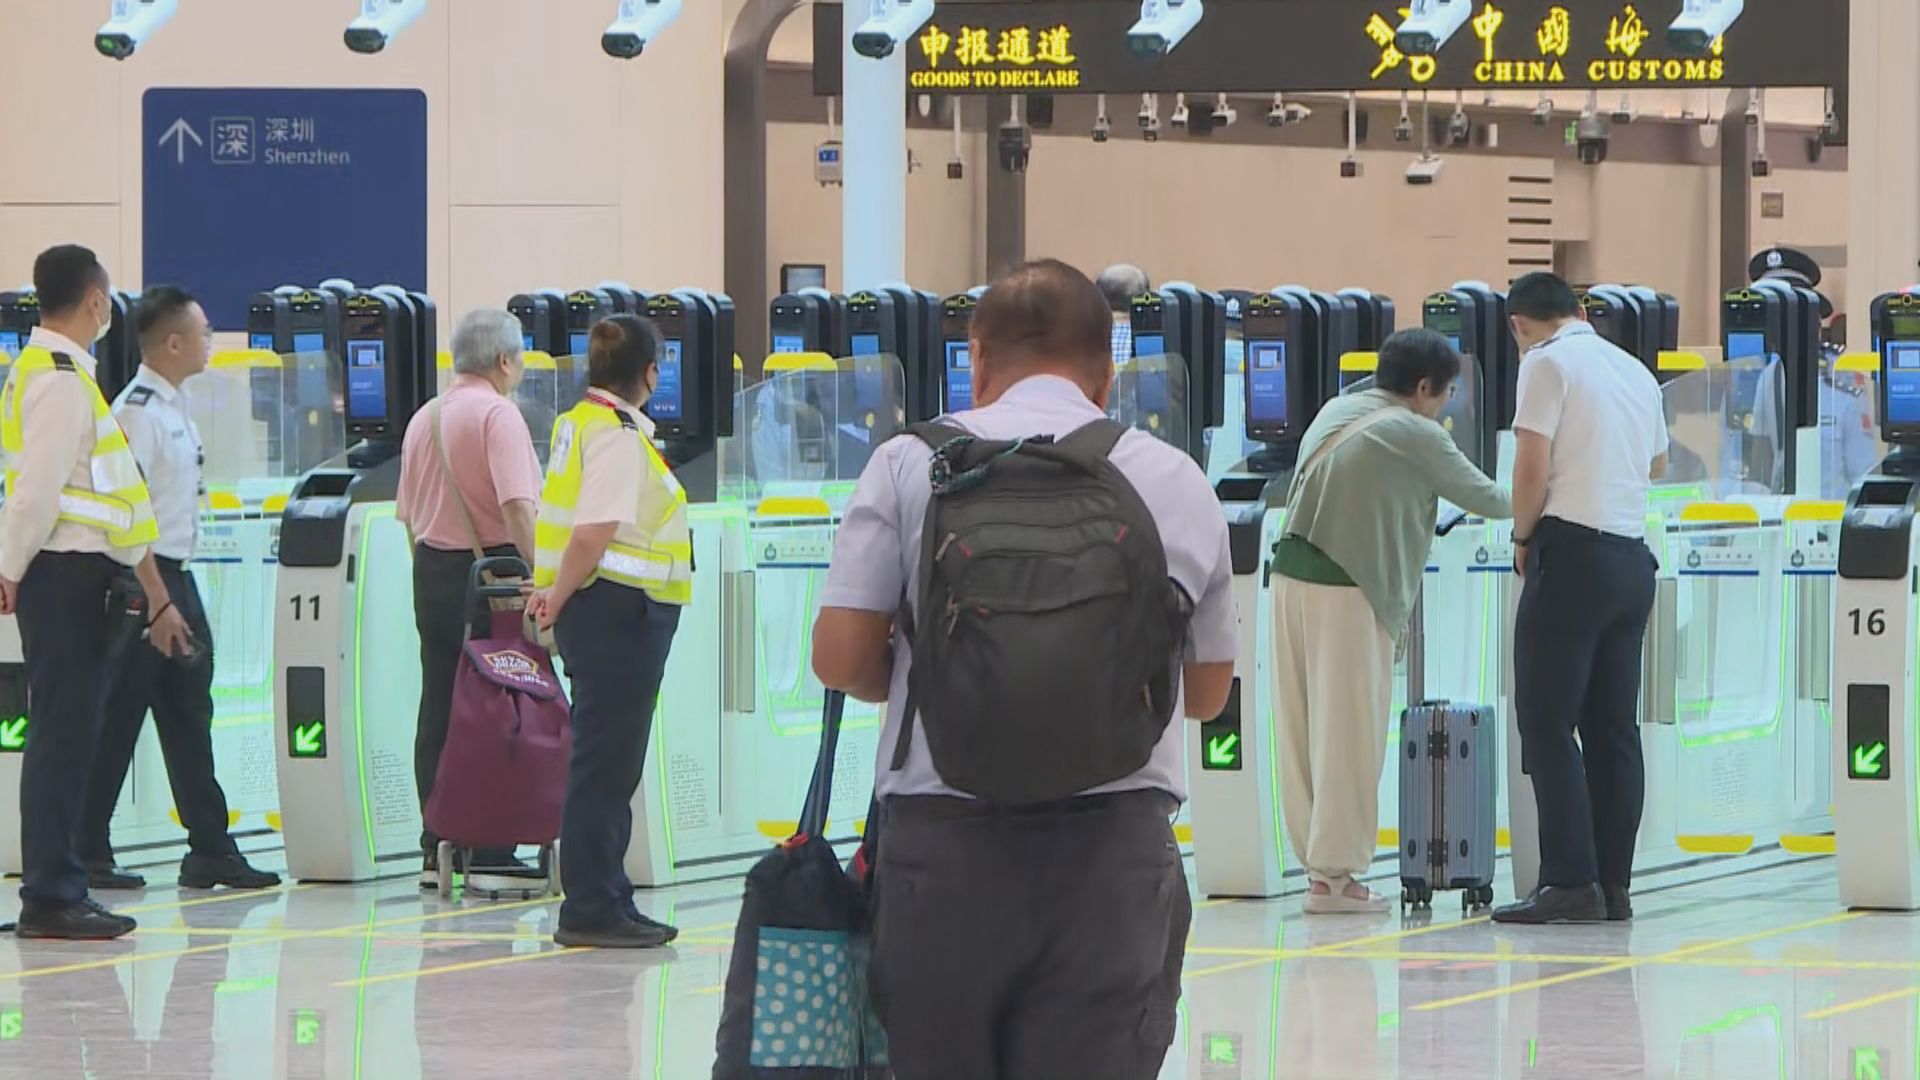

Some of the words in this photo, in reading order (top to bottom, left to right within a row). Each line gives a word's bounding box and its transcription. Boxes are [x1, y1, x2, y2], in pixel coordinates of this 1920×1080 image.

[1472, 3, 1723, 61] 中國海
[919, 24, 1077, 69] 申报通道
[911, 70, 970, 88] GOODS
[973, 70, 997, 88] TO
[1000, 69, 1079, 88] DECLARE
[1474, 60, 1564, 82] CHINA
[1587, 59, 1724, 81] CUSTOMS
[216, 123, 249, 157] 深
[265, 117, 315, 143] 深圳
[264, 147, 350, 165] Shenzhen
[290, 594, 320, 621] 11
[1847, 607, 1886, 636] 16
